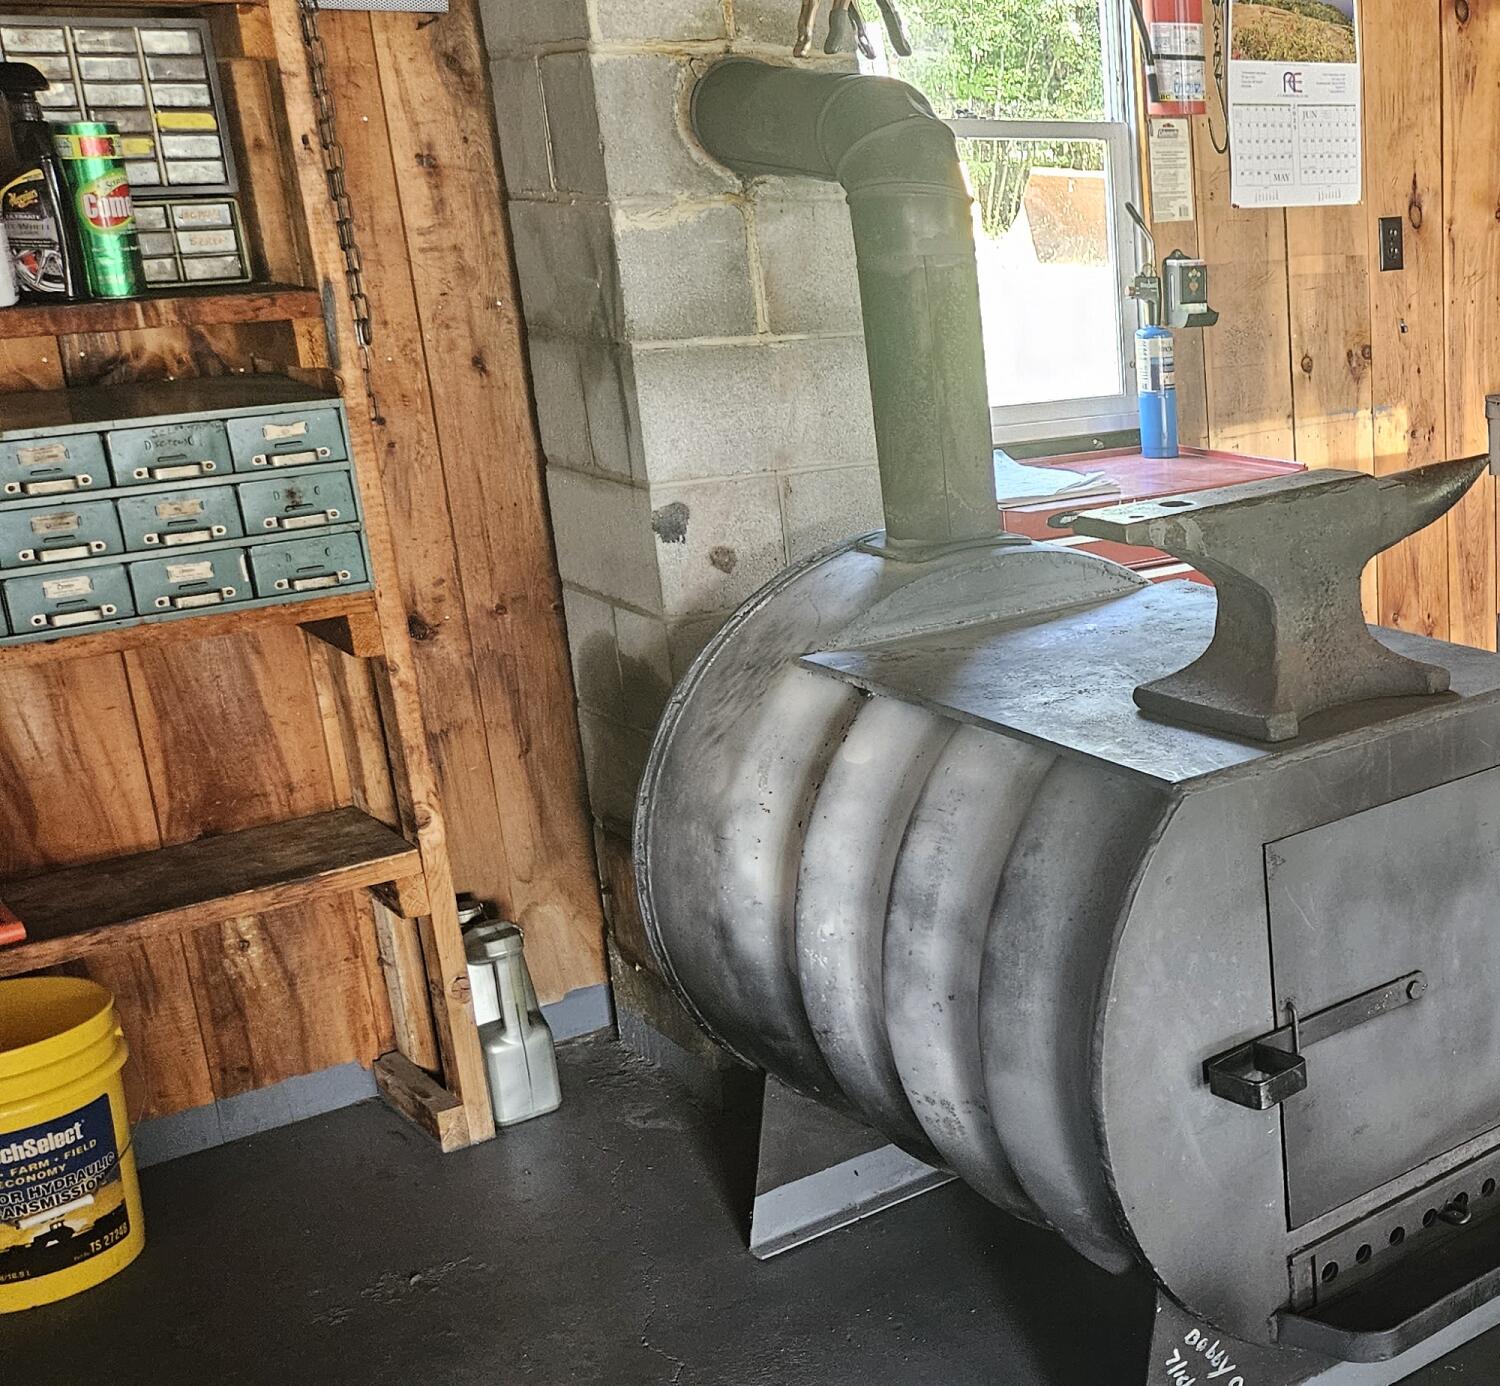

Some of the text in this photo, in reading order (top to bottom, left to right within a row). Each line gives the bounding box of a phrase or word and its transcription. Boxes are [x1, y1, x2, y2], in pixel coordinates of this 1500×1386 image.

[1302, 110, 1318, 120] JUN
[1273, 173, 1290, 182] MAY
[11, 1138, 97, 1177] FARM FIELD
[28, 1151, 116, 1200] HYDRAULIC
[90, 1237, 103, 1254] TS
